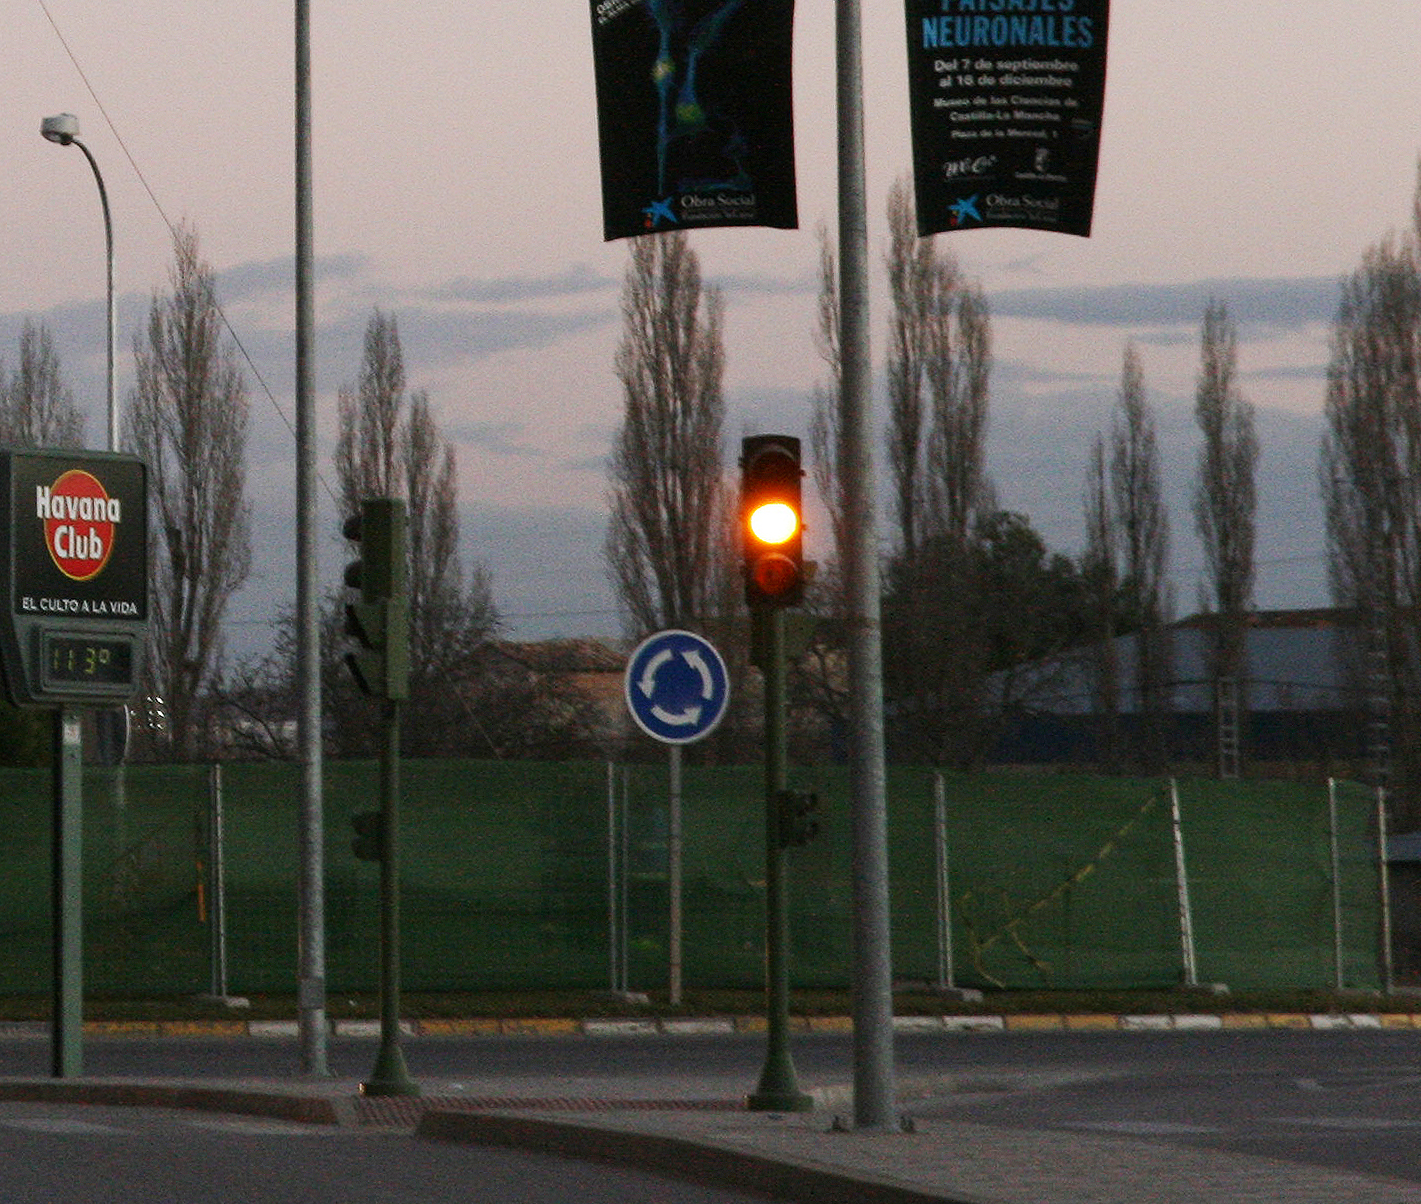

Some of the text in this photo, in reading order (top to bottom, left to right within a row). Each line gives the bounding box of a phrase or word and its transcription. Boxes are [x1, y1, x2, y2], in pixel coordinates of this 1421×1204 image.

[922, 15, 1094, 48] NEURONALES
[934, 58, 1079, 73] Del 7 de septiembre
[939, 75, 952, 87] al
[977, 74, 996, 86] de
[999, 74, 1073, 87] diciembre
[681, 193, 755, 207] Obra Social
[986, 194, 1059, 210] Obra Social
[36, 485, 121, 523] Havana
[54, 525, 104, 559] Club
[22, 597, 138, 614] EL CULTO A LA VIDA
